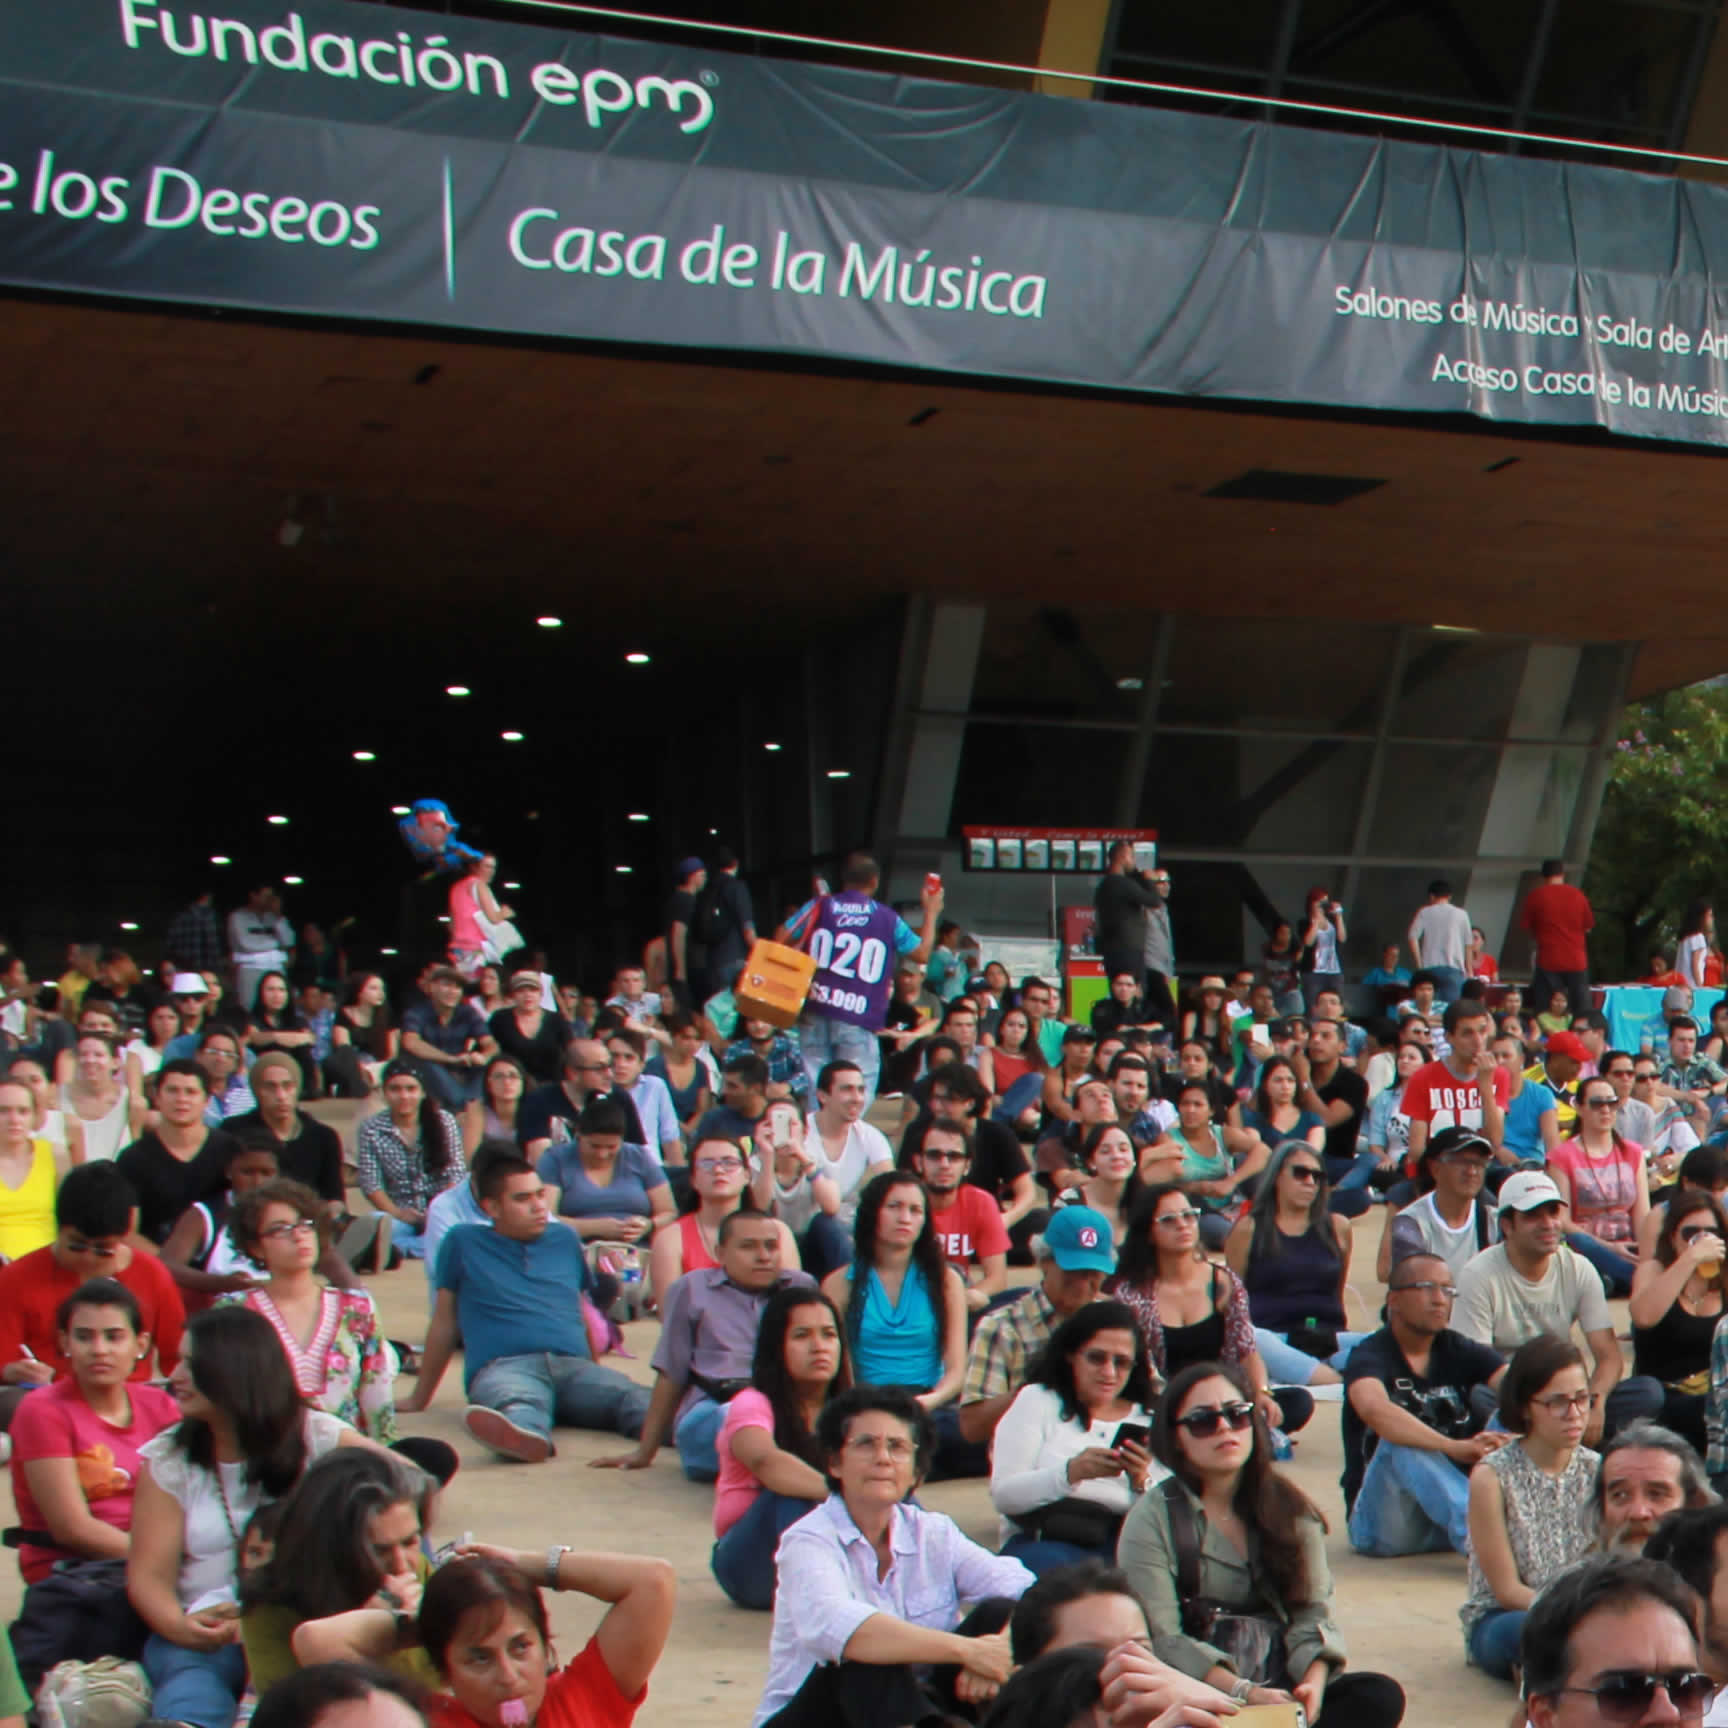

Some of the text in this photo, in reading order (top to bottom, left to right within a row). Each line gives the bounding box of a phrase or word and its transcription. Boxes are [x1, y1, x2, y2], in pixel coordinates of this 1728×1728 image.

[119, 0, 714, 134] Fundación epm
[31, 149, 129, 223] los
[145, 165, 382, 250] Deseos
[508, 207, 1048, 319] Casa de la Música
[1335, 285, 1444, 325] Salones
[1484, 301, 1580, 338] Música
[1596, 314, 1653, 351] Sala
[1658, 323, 1692, 357] de
[1523, 364, 1596, 397] Casa
[1627, 376, 1652, 410] la
[1429, 1085, 1497, 1110] MOSC
